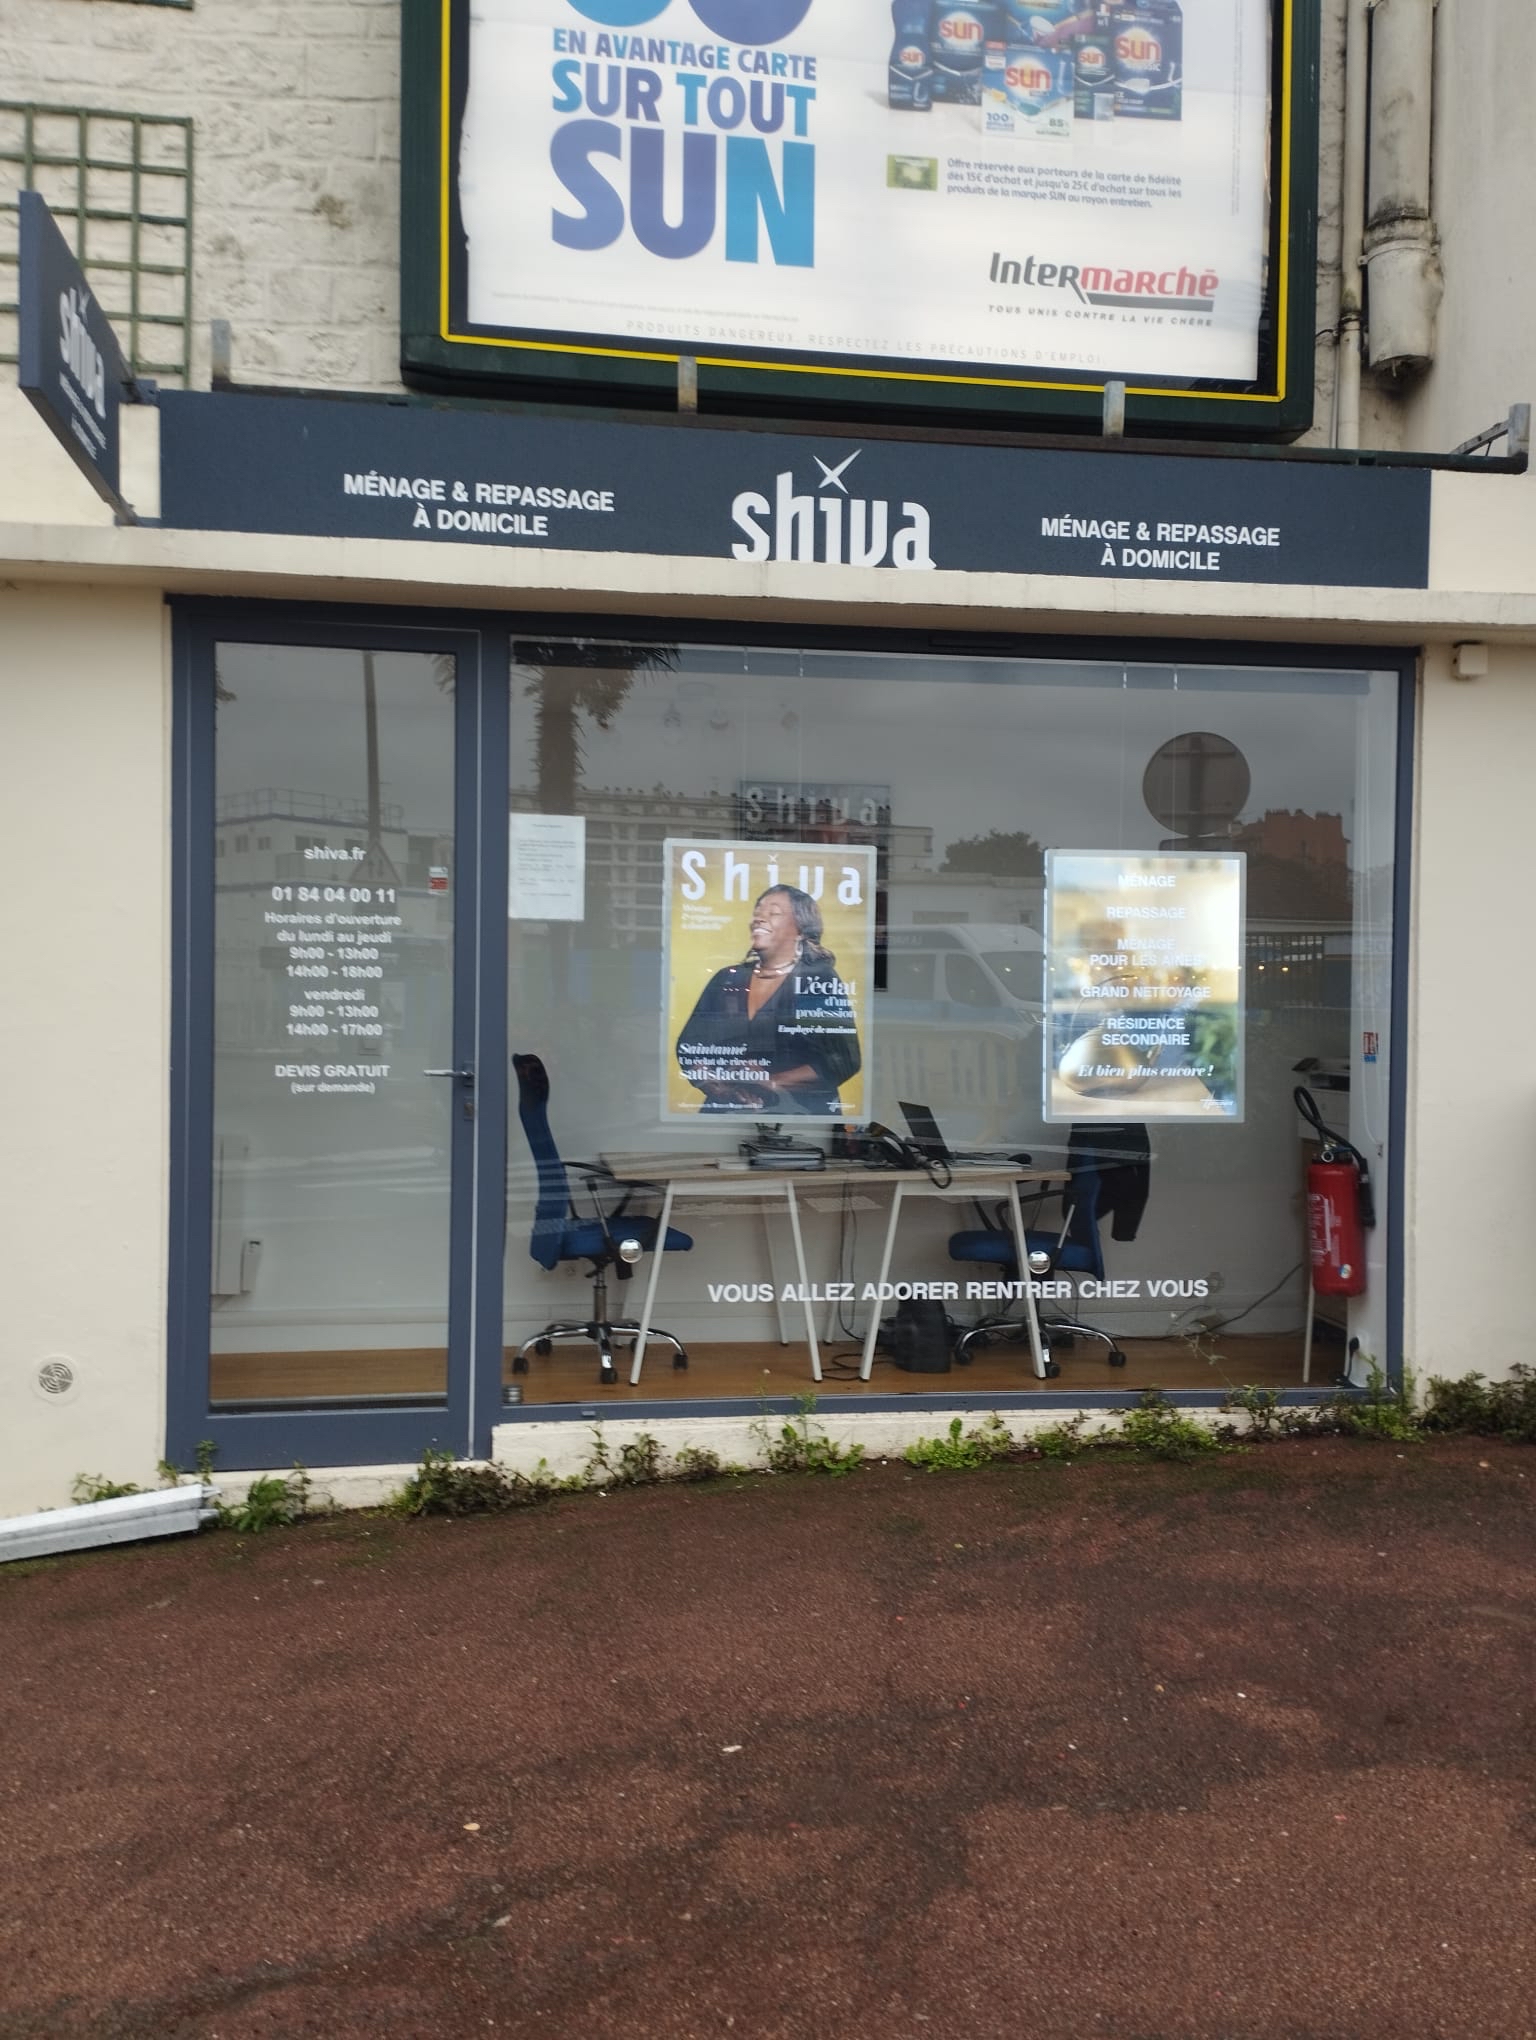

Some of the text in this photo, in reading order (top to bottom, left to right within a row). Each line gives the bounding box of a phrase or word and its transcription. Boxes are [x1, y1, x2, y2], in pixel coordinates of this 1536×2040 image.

[938, 20, 984, 40] sun
[554, 28, 817, 81] EN AVANTAGE CARTE
[1115, 35, 1162, 60] sun
[1005, 67, 1051, 90] sun
[552, 59, 816, 137] SUR TOUT
[549, 119, 815, 268] SUN
[989, 305, 1021, 315] TOUS
[1028, 307, 1058, 317] UNIS
[1065, 310, 1115, 321] CONTRE
[1121, 313, 1136, 323] LA
[1143, 315, 1164, 325] VIE
[343, 470, 615, 512] MÉNAGE & REPASSAGE
[731, 449, 937, 570] shiva
[412, 502, 549, 537] À DOMICILE
[1041, 514, 1281, 547] MÉNAGE & REPASSAGE
[1100, 543, 1221, 571] À DOMICILE
[304, 845, 366, 861] shiva.fr
[271, 886, 293, 902] 01
[323, 887, 347, 903] 04
[349, 887, 372, 903] 00
[375, 888, 396, 904] 11
[264, 911, 402, 926] Horaires d'ouverture
[1106, 905, 1187, 920] REPASSAGE
[276, 928, 392, 946] du lundi au jeudi
[289, 946, 325, 960] 9h00
[336, 947, 380, 960] 13h00
[1089, 954, 1129, 966] POUR
[286, 964, 329, 978] 14h00
[303, 988, 366, 1001] vendredi
[1080, 986, 1212, 999] GRAND NETTOYAGE
[289, 1004, 325, 1018] 9h00
[336, 1005, 380, 1018] 13h00
[795, 1007, 857, 1020] profession
[285, 1022, 329, 1036] 14h00
[340, 1023, 383, 1036] 17h00
[1107, 1015, 1185, 1030] RÉSIDENCE
[1102, 1033, 1190, 1046] SECONDAIRE
[274, 1064, 391, 1077] DEVIS GRATUIT
[678, 1066, 770, 1081] satisfaction
[1077, 1064, 1093, 1077] Et
[1096, 1064, 1124, 1077] bien
[1127, 1064, 1158, 1080] plus
[290, 1081, 376, 1095] (sur demande)
[707, 1279, 1209, 1303] VOUS ALLEZ ADORER RENTRER CHEZ VOUS
